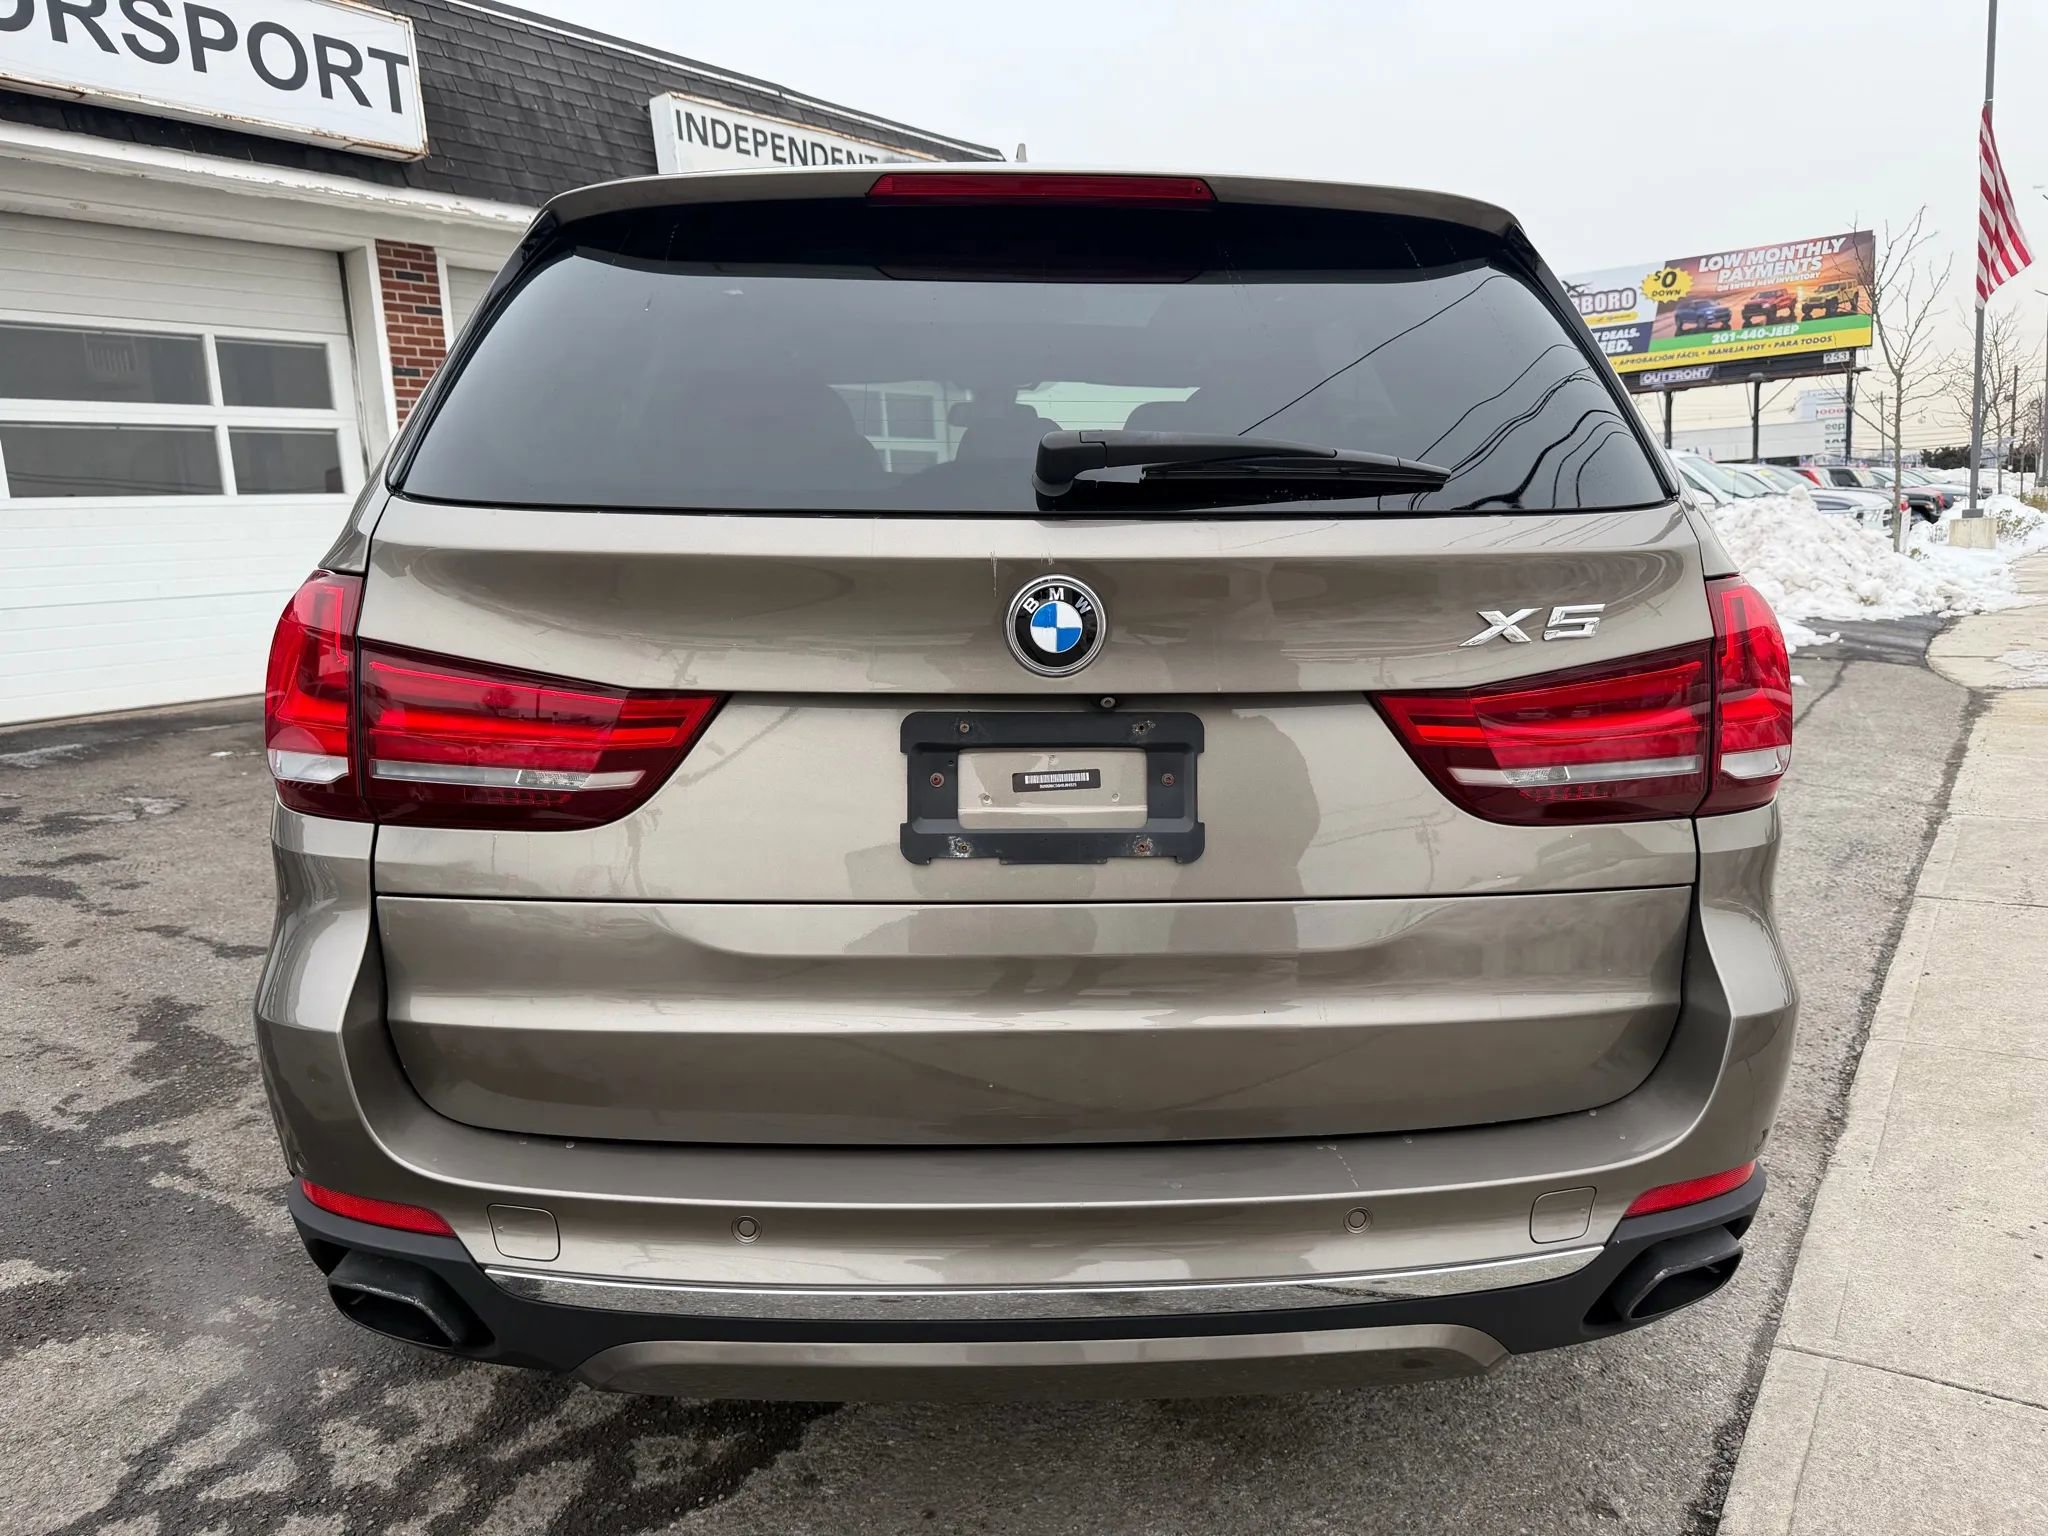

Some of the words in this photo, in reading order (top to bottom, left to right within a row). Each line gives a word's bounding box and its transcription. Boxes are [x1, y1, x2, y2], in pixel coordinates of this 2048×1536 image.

[1699, 252, 1744, 272] LOW
[1746, 238, 1846, 265] MONTHLY
[1719, 256, 1822, 283] PAYMENTS
[1776, 271, 1821, 284] INVENTORY
[1652, 289, 1681, 297] DOWN
[1601, 328, 1639, 340] DEALS.
[1712, 324, 1800, 344] 201-440-JEEP
[1747, 343, 1766, 352] HOY
[1774, 339, 1798, 349] PARA
[1801, 335, 1833, 345] TODOS
[1643, 367, 1710, 383] OUTFRONT
[1825, 423, 1845, 431] eep
[1022, 587, 1092, 614] BMW
[1459, 603, 1606, 647] X5
